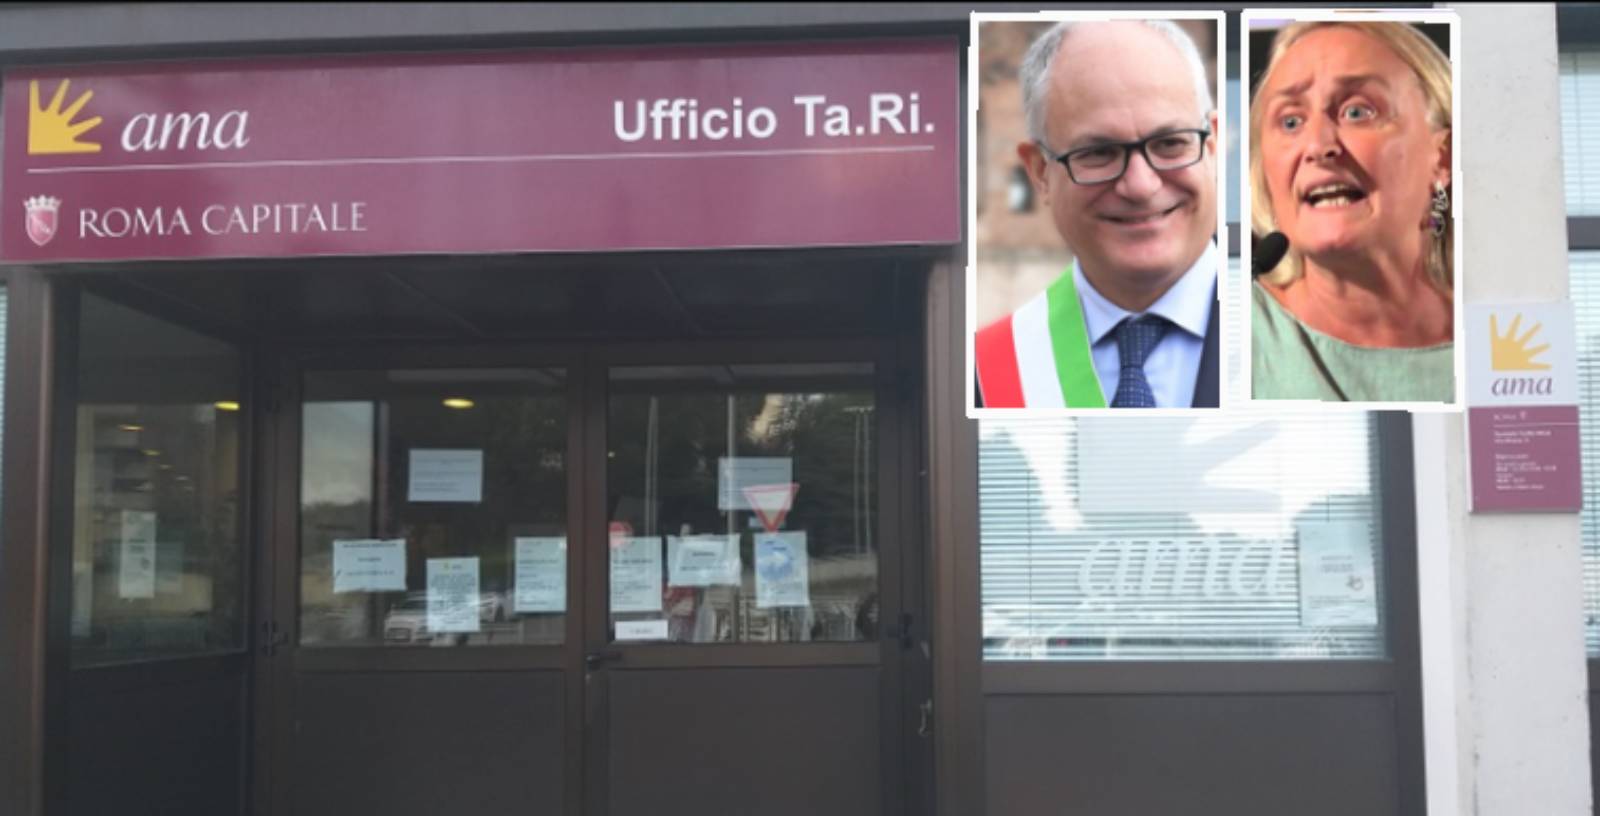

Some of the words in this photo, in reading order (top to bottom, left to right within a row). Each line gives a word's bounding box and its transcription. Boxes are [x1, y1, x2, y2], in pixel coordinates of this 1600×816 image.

[120, 109, 251, 152] ama
[613, 98, 778, 142] Ufficio
[794, 91, 936, 137] Ta.Ri.
[79, 205, 192, 238] ROMA
[200, 201, 369, 235] CAPITALE
[1490, 376, 1554, 397] ama
[1078, 538, 1294, 598] ama
